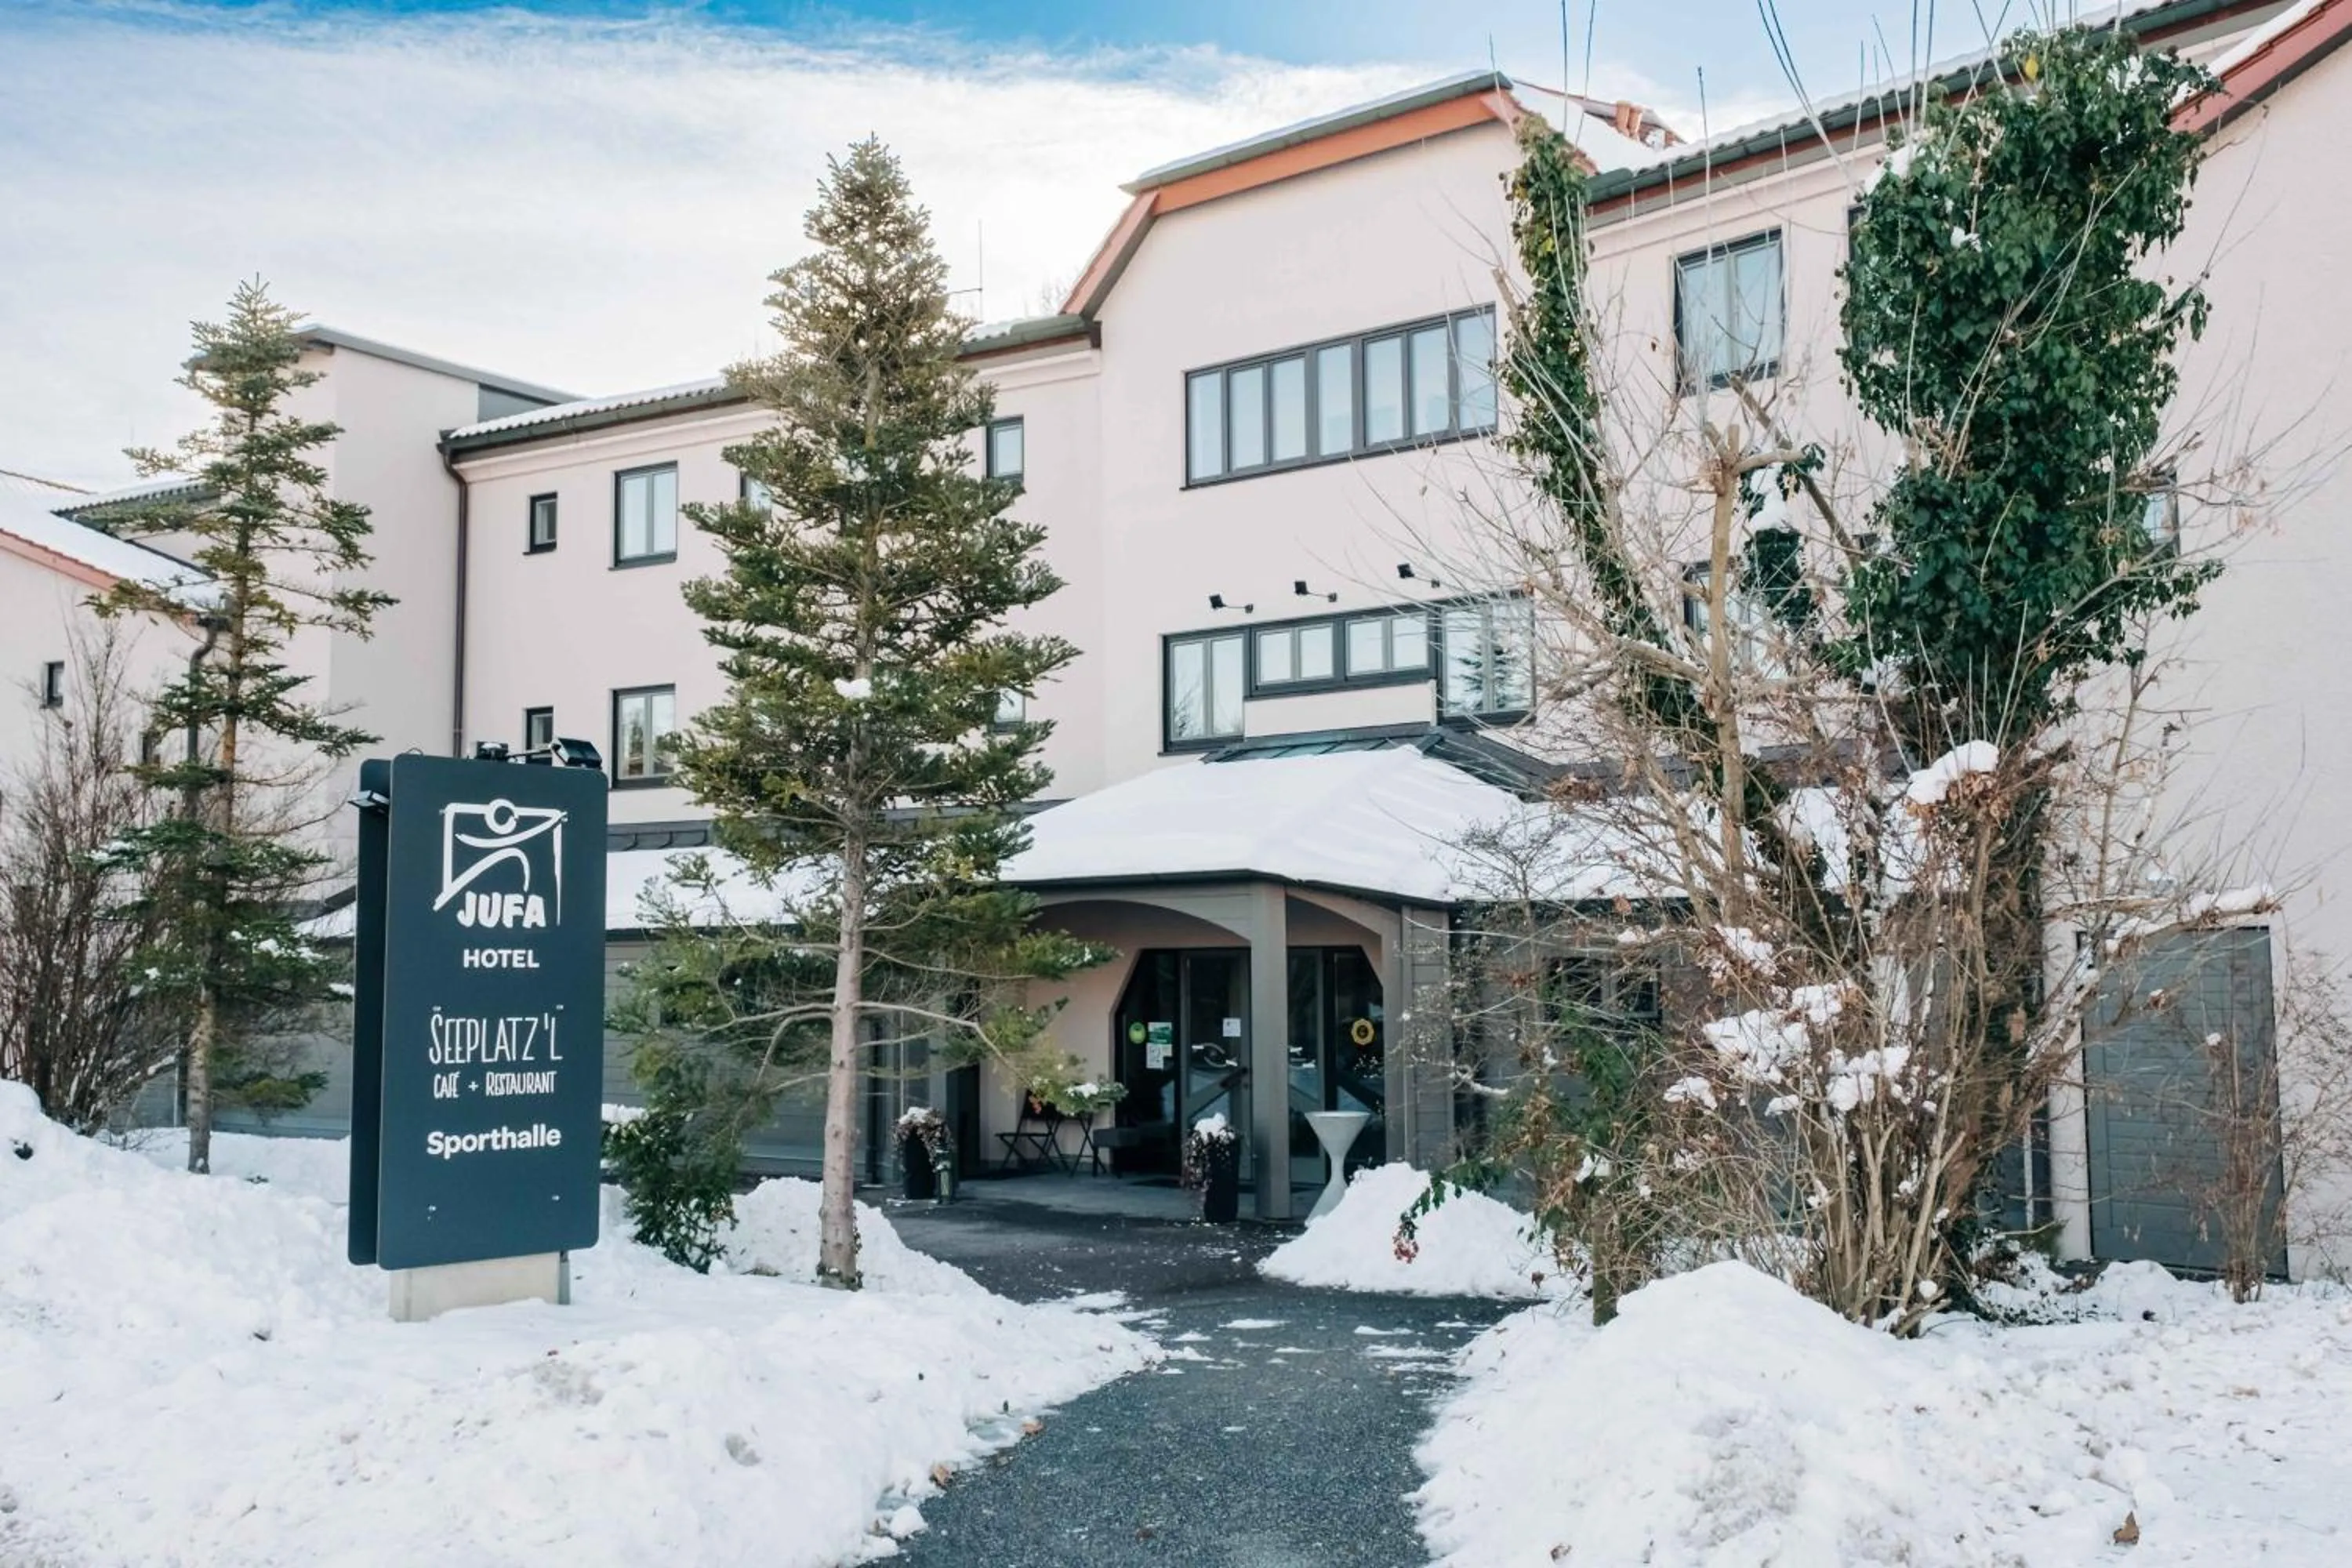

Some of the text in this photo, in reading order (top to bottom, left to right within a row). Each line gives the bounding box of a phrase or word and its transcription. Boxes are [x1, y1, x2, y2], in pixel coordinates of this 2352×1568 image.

[456, 891, 546, 929] JUFA
[463, 948, 540, 968] HOTEL
[485, 1070, 557, 1096] RESTAURANT
[426, 1123, 562, 1160] Sporthalle
